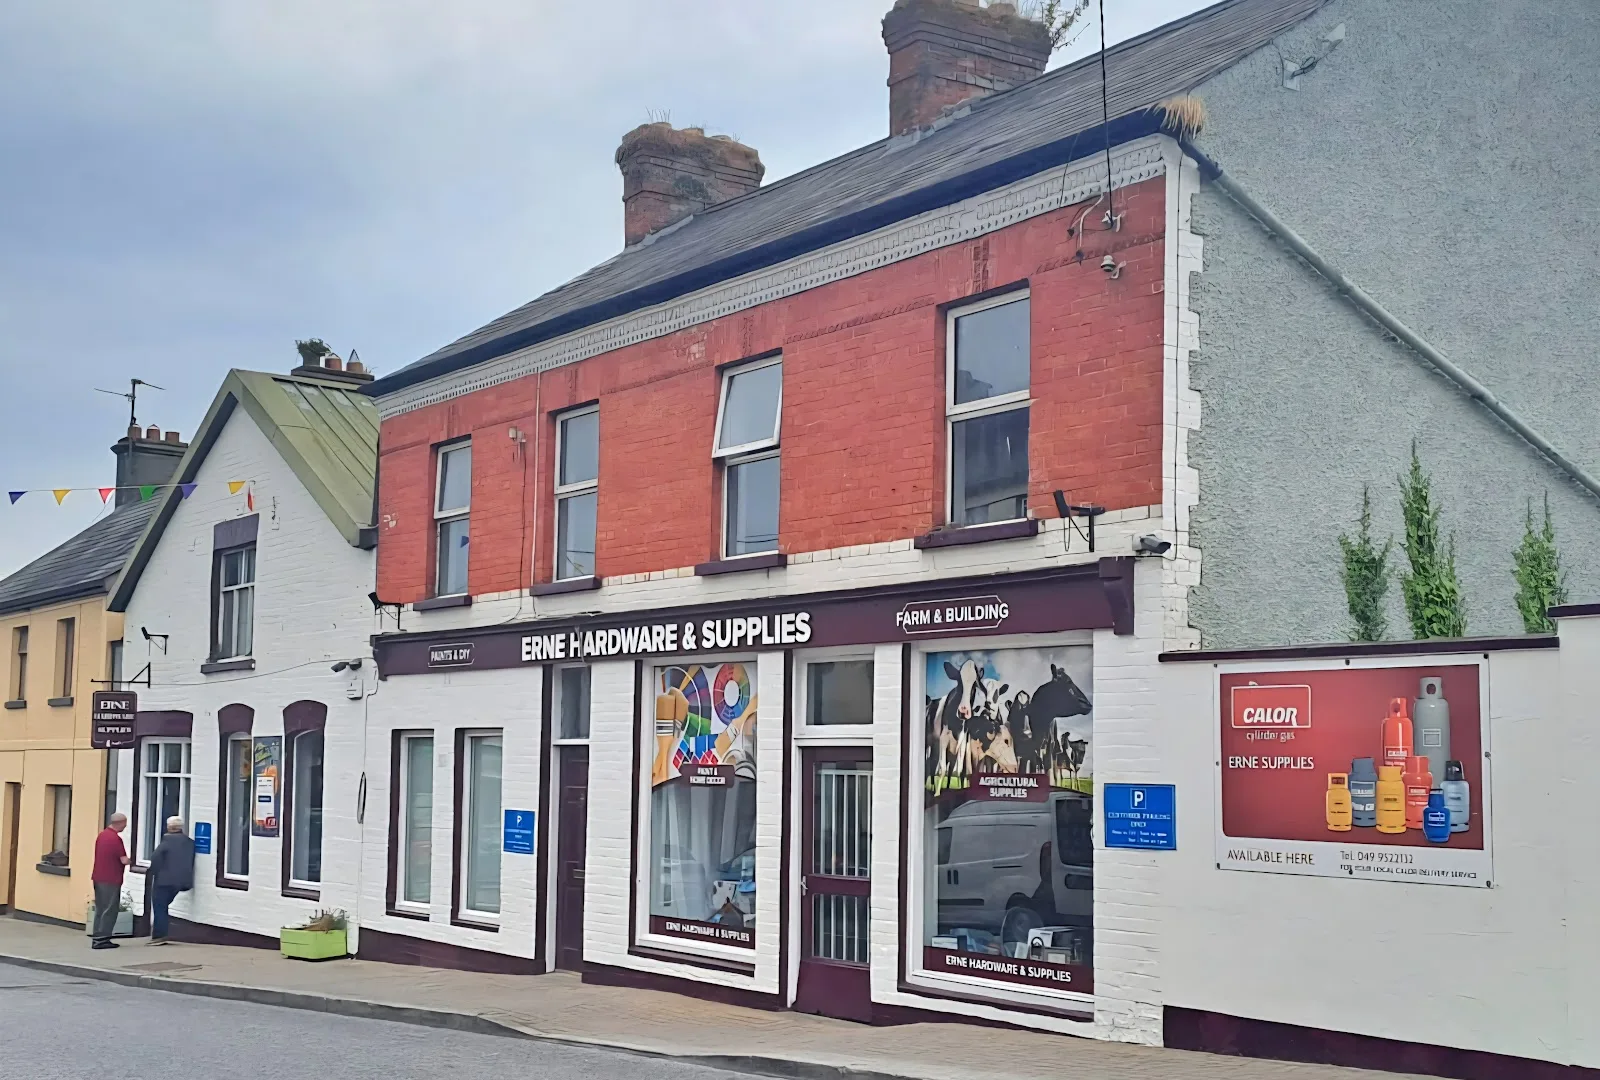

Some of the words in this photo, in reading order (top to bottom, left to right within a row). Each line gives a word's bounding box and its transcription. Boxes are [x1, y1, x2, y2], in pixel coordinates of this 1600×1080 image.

[896, 609, 930, 627] FARM
[933, 609, 942, 623] &
[945, 603, 1009, 622] BUILDING
[521, 633, 565, 661] ERNE
[570, 624, 678, 658] HARDWARE
[682, 621, 698, 650] &
[701, 611, 811, 648] SUPPLIES
[1243, 707, 1298, 728] CALOR
[1229, 756, 1259, 769] ERNE
[1261, 756, 1315, 770] SUPPLIES
[979, 776, 1039, 788] AGRICULTURAL
[989, 787, 1028, 798] SUPPLIES
[1134, 790, 1144, 807] P
[1227, 849, 1283, 864] AVAILABLE
[1286, 852, 1316, 866] HERE
[1357, 851, 1375, 862] 049
[945, 955, 968, 968] ERNE
[968, 958, 1019, 975] HARDWARE
[1028, 966, 1072, 982] SUPPLIES
